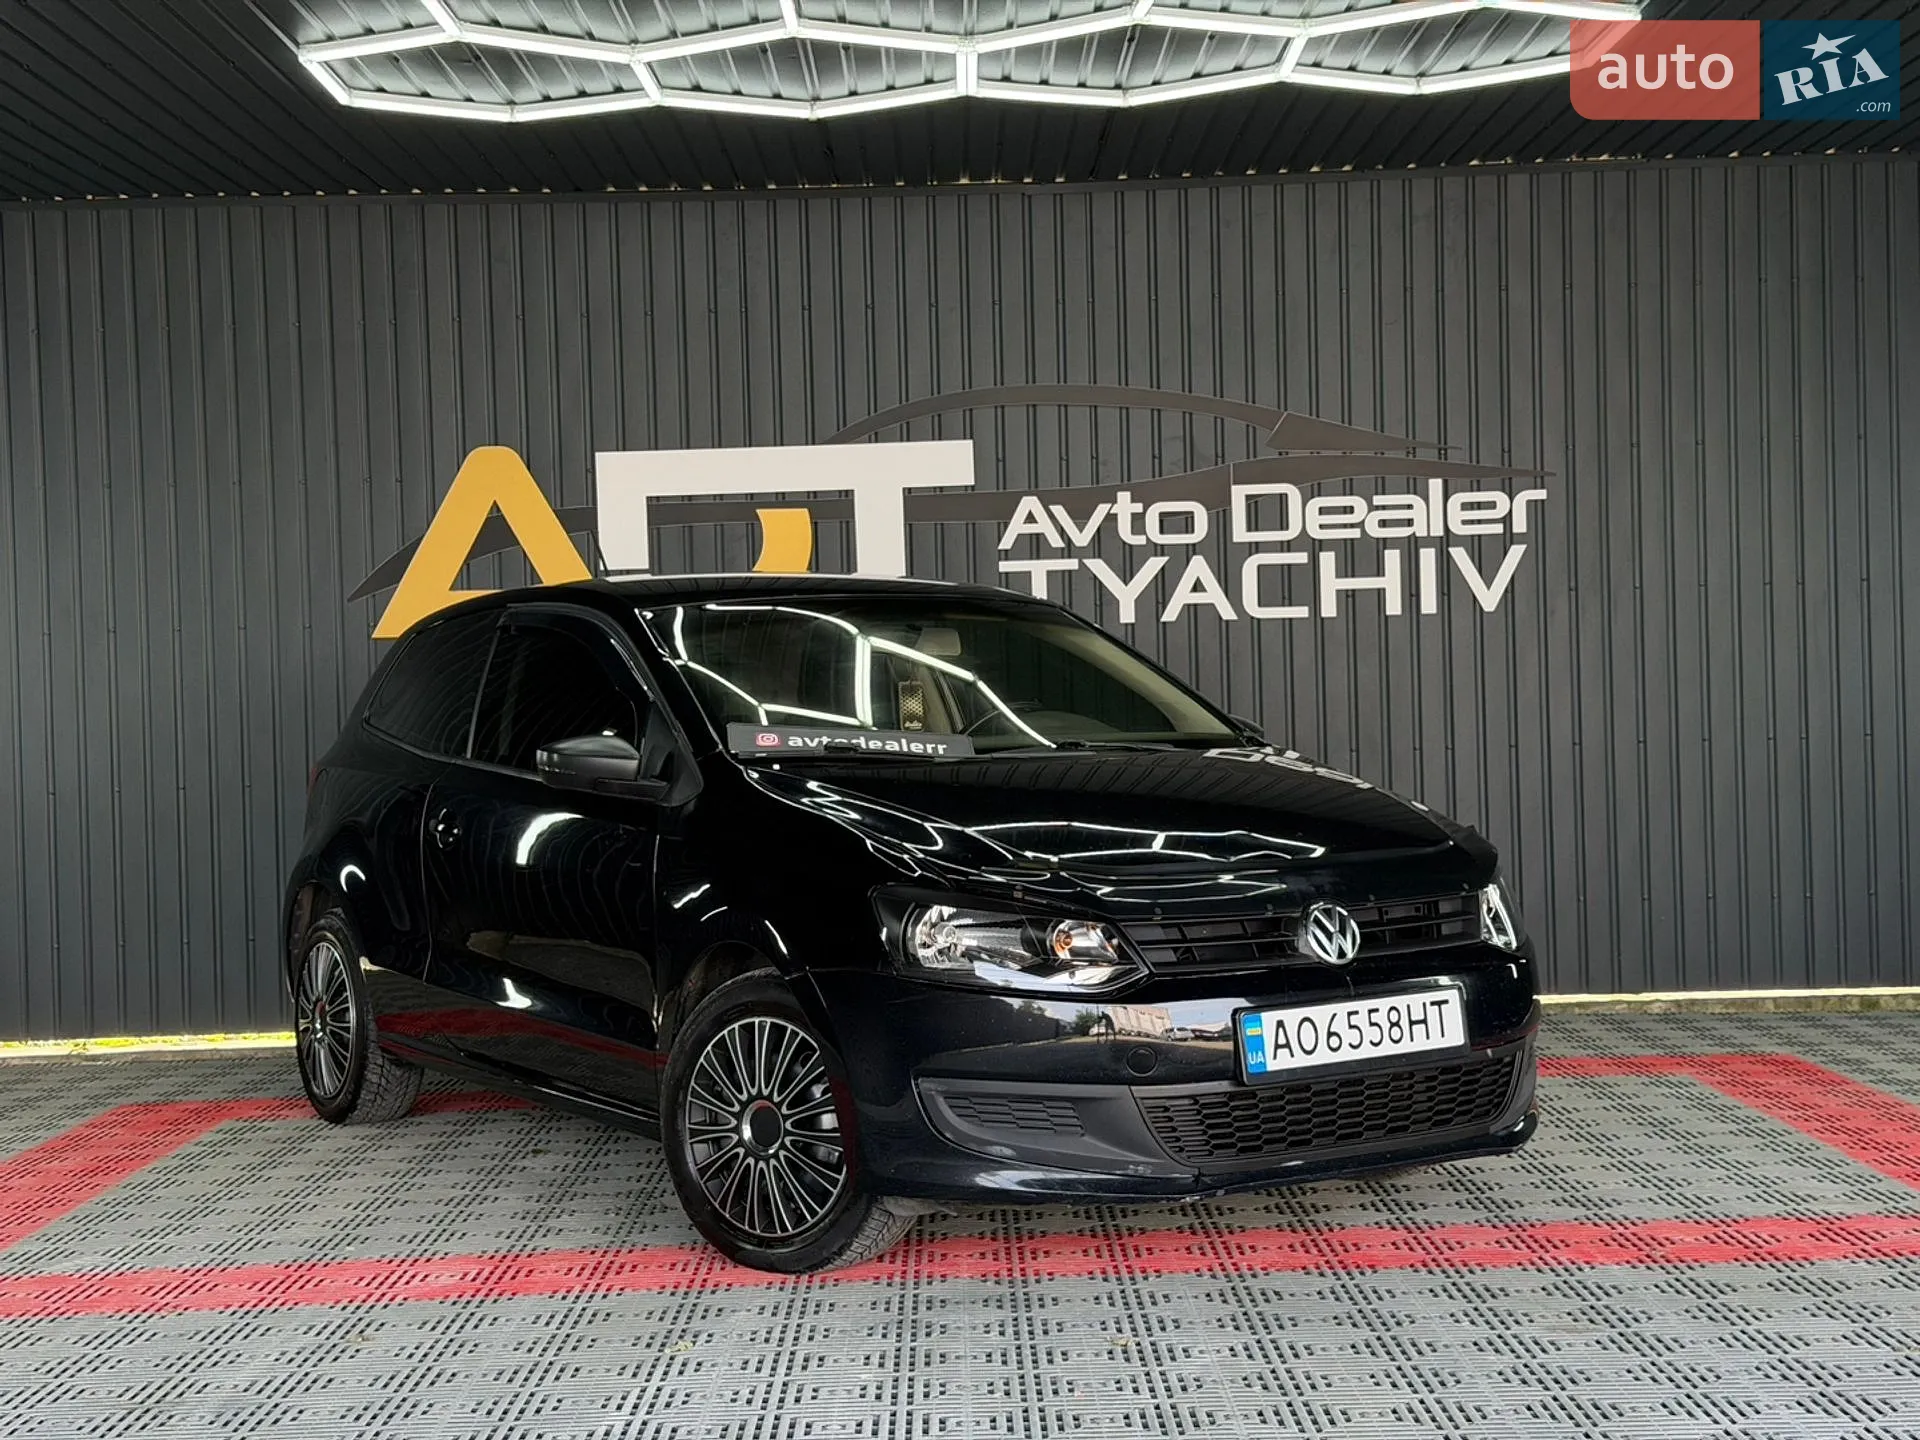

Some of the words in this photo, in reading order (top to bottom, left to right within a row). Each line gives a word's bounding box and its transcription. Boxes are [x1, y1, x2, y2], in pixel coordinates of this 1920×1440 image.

[998, 491, 1208, 550] Avto
[1232, 479, 1547, 543] Dealer
[998, 544, 1528, 624] TYACHIV
[1249, 1052, 1265, 1065] UA
[1273, 999, 1449, 1061] AO6558HT
